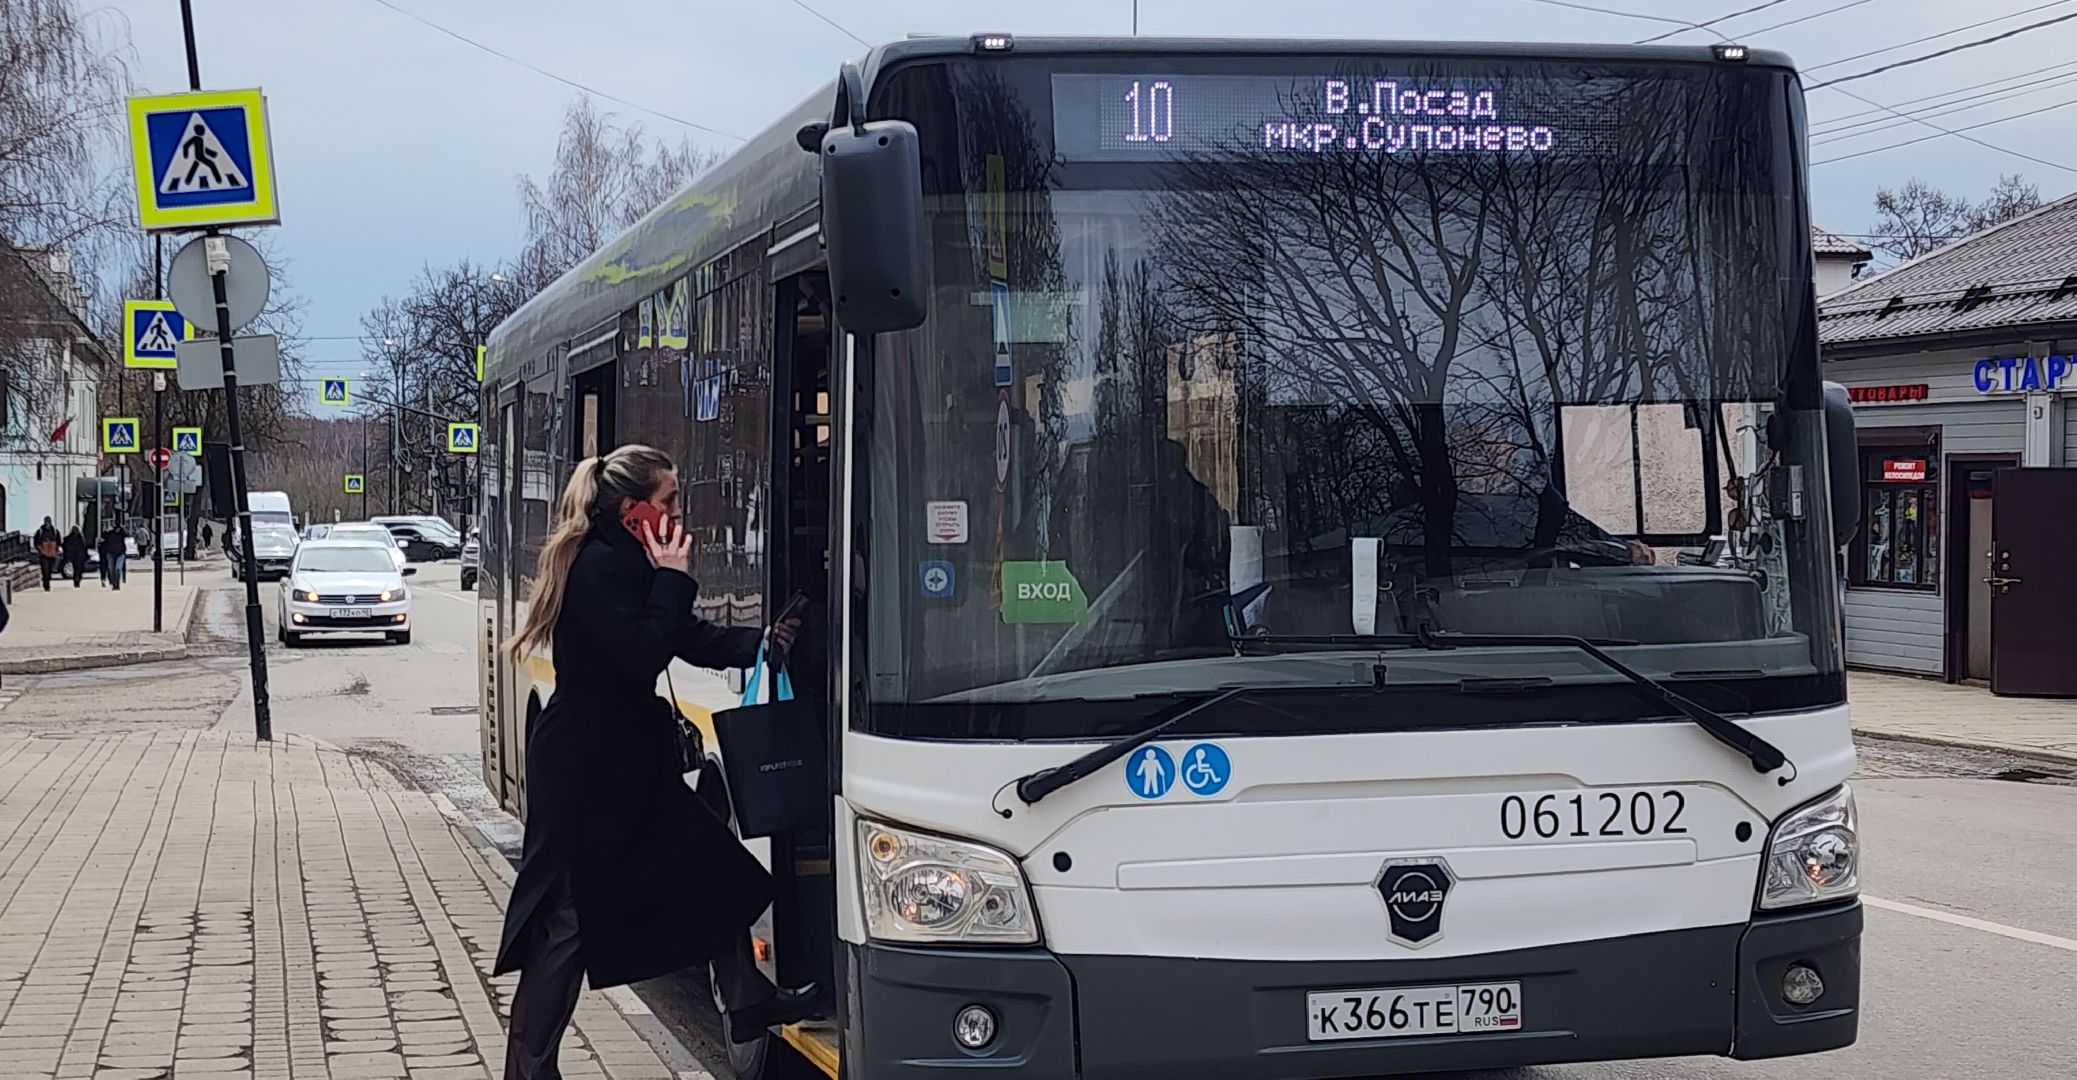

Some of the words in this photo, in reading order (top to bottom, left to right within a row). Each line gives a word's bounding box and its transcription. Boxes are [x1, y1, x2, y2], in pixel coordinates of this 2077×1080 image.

[1125, 81, 1173, 142] 10
[1326, 81, 1497, 120] В.Посад
[1265, 115, 1553, 153] мкр.Супонево
[1018, 583, 1071, 602] ВХОД
[1500, 790, 1687, 839] 061202
[1320, 995, 1454, 1034] К366ТЕ
[1461, 987, 1512, 1016] 790
[1474, 1016, 1499, 1027] RUS
